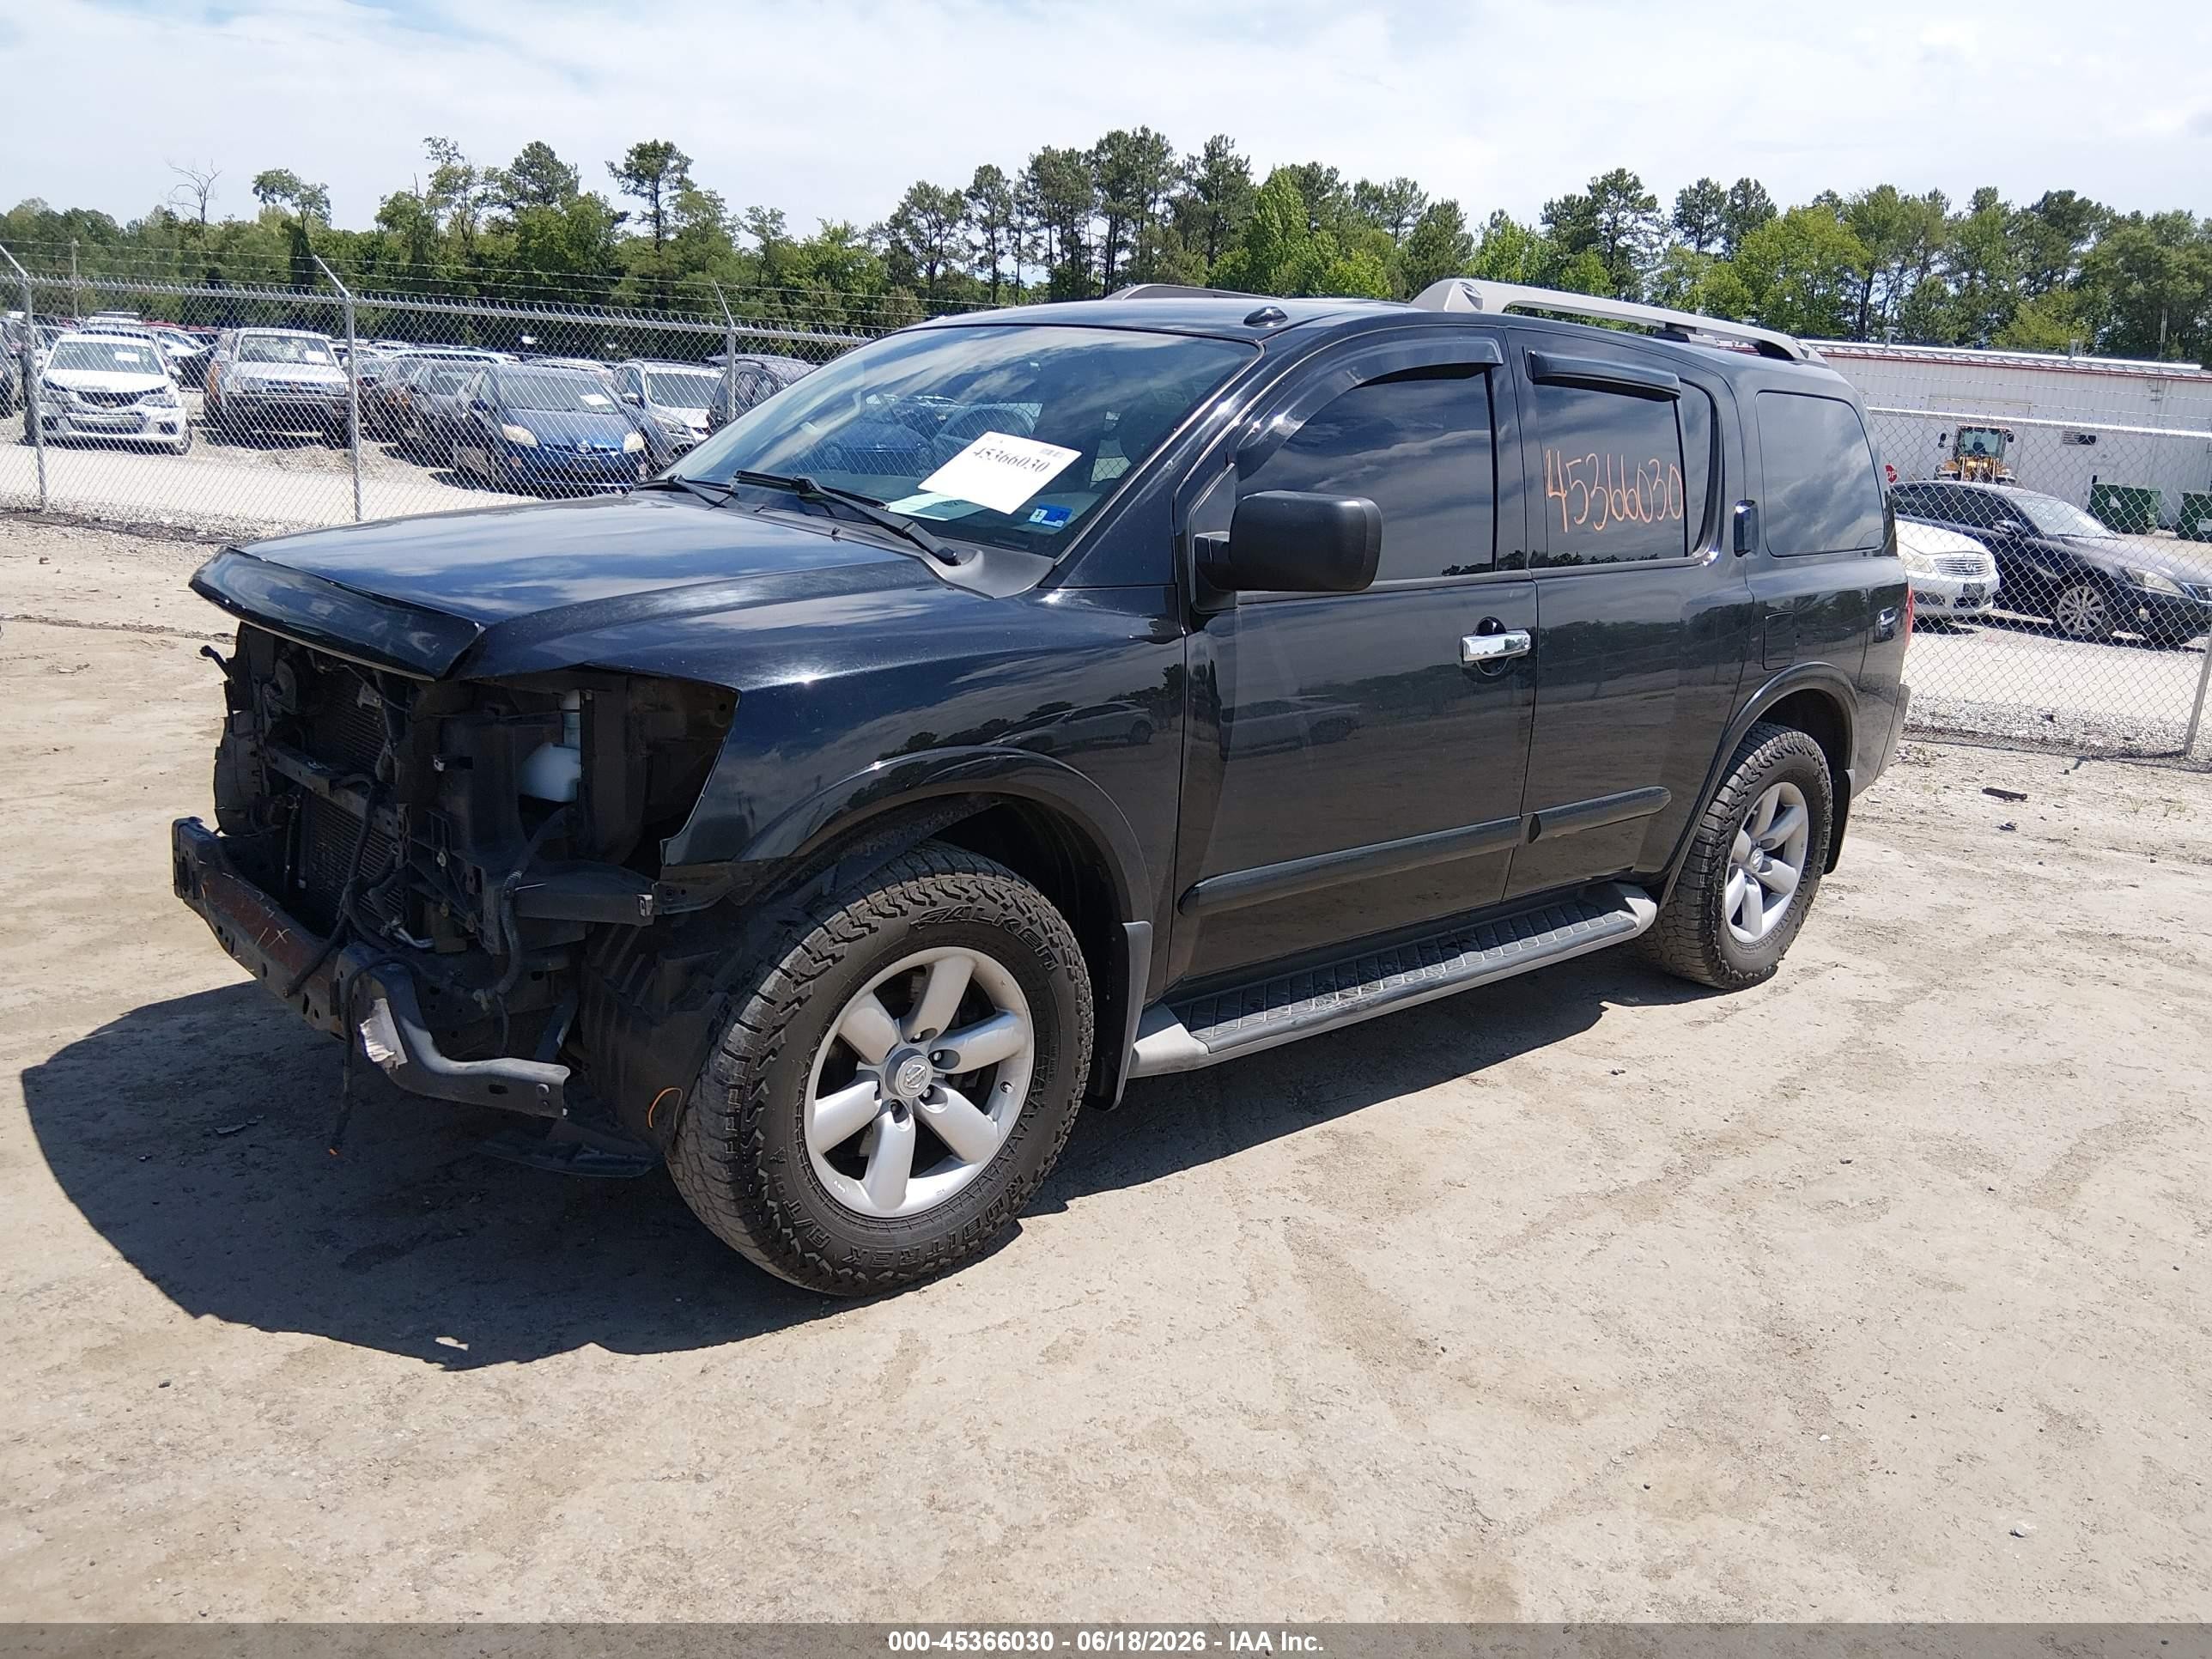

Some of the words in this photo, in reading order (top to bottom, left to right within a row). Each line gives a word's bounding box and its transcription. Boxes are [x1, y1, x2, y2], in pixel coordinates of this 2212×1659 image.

[973, 447, 1050, 472] 45366030
[1547, 448, 1683, 532] 45366030
[910, 904, 1059, 971] FALKEN
[782, 1199, 832, 1248] A/T
[841, 1170, 1024, 1267] RUBITREK
